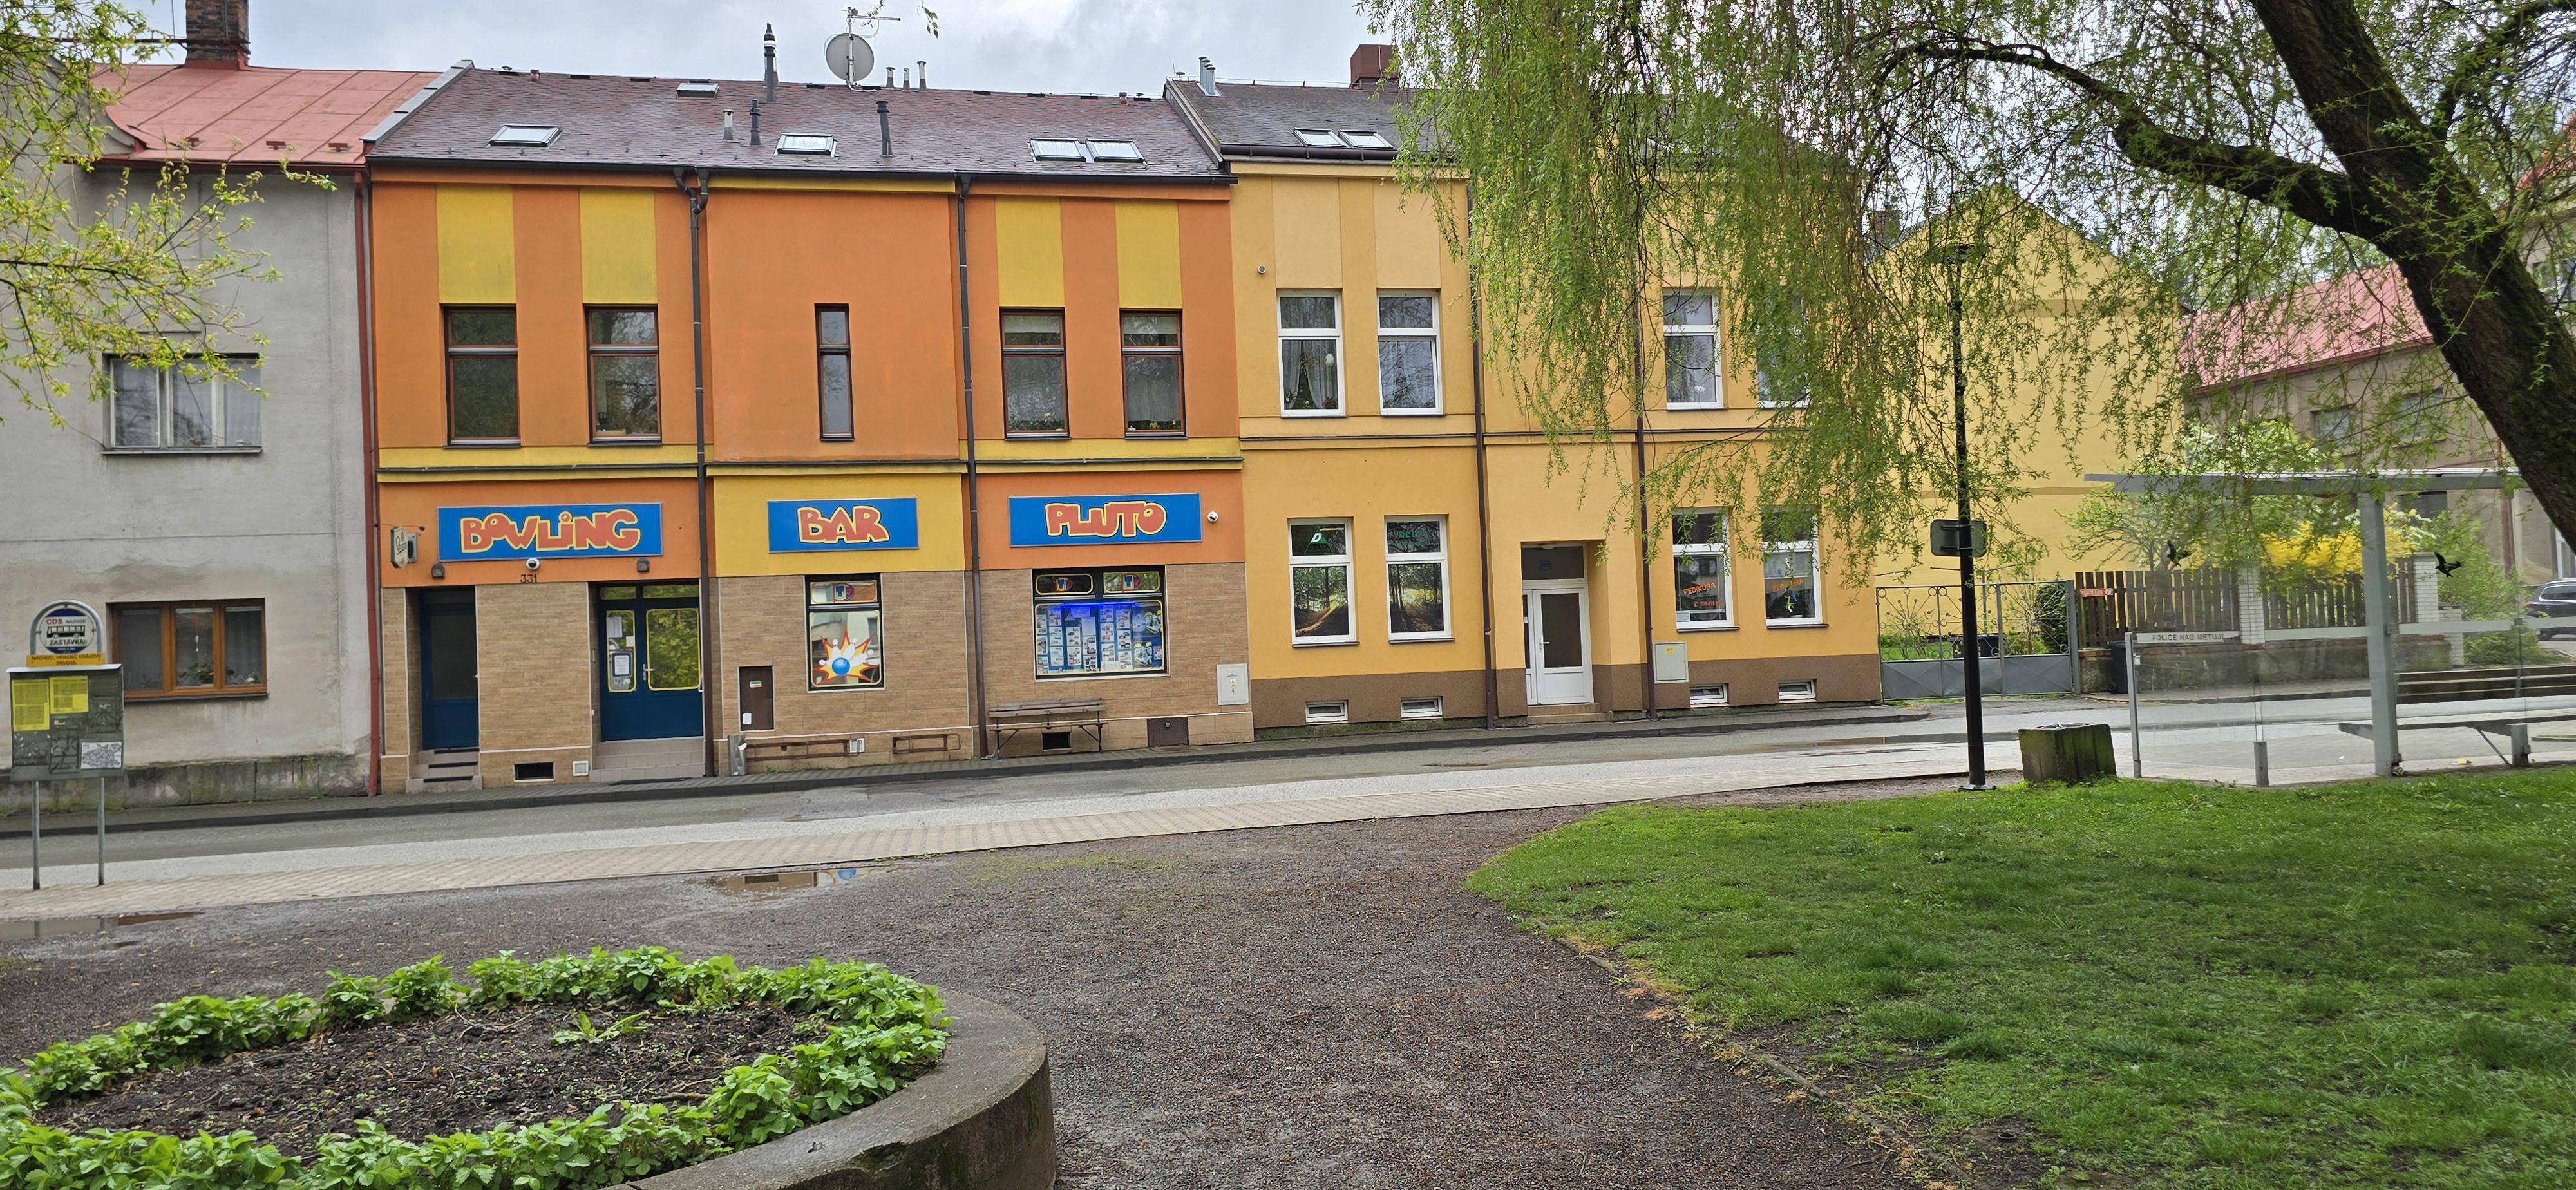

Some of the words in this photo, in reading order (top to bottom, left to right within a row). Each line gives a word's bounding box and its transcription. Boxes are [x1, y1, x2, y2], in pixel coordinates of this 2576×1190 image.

[797, 505, 891, 543] BAR
[1045, 500, 1167, 537] PLUTO
[520, 574, 537, 584] 331
